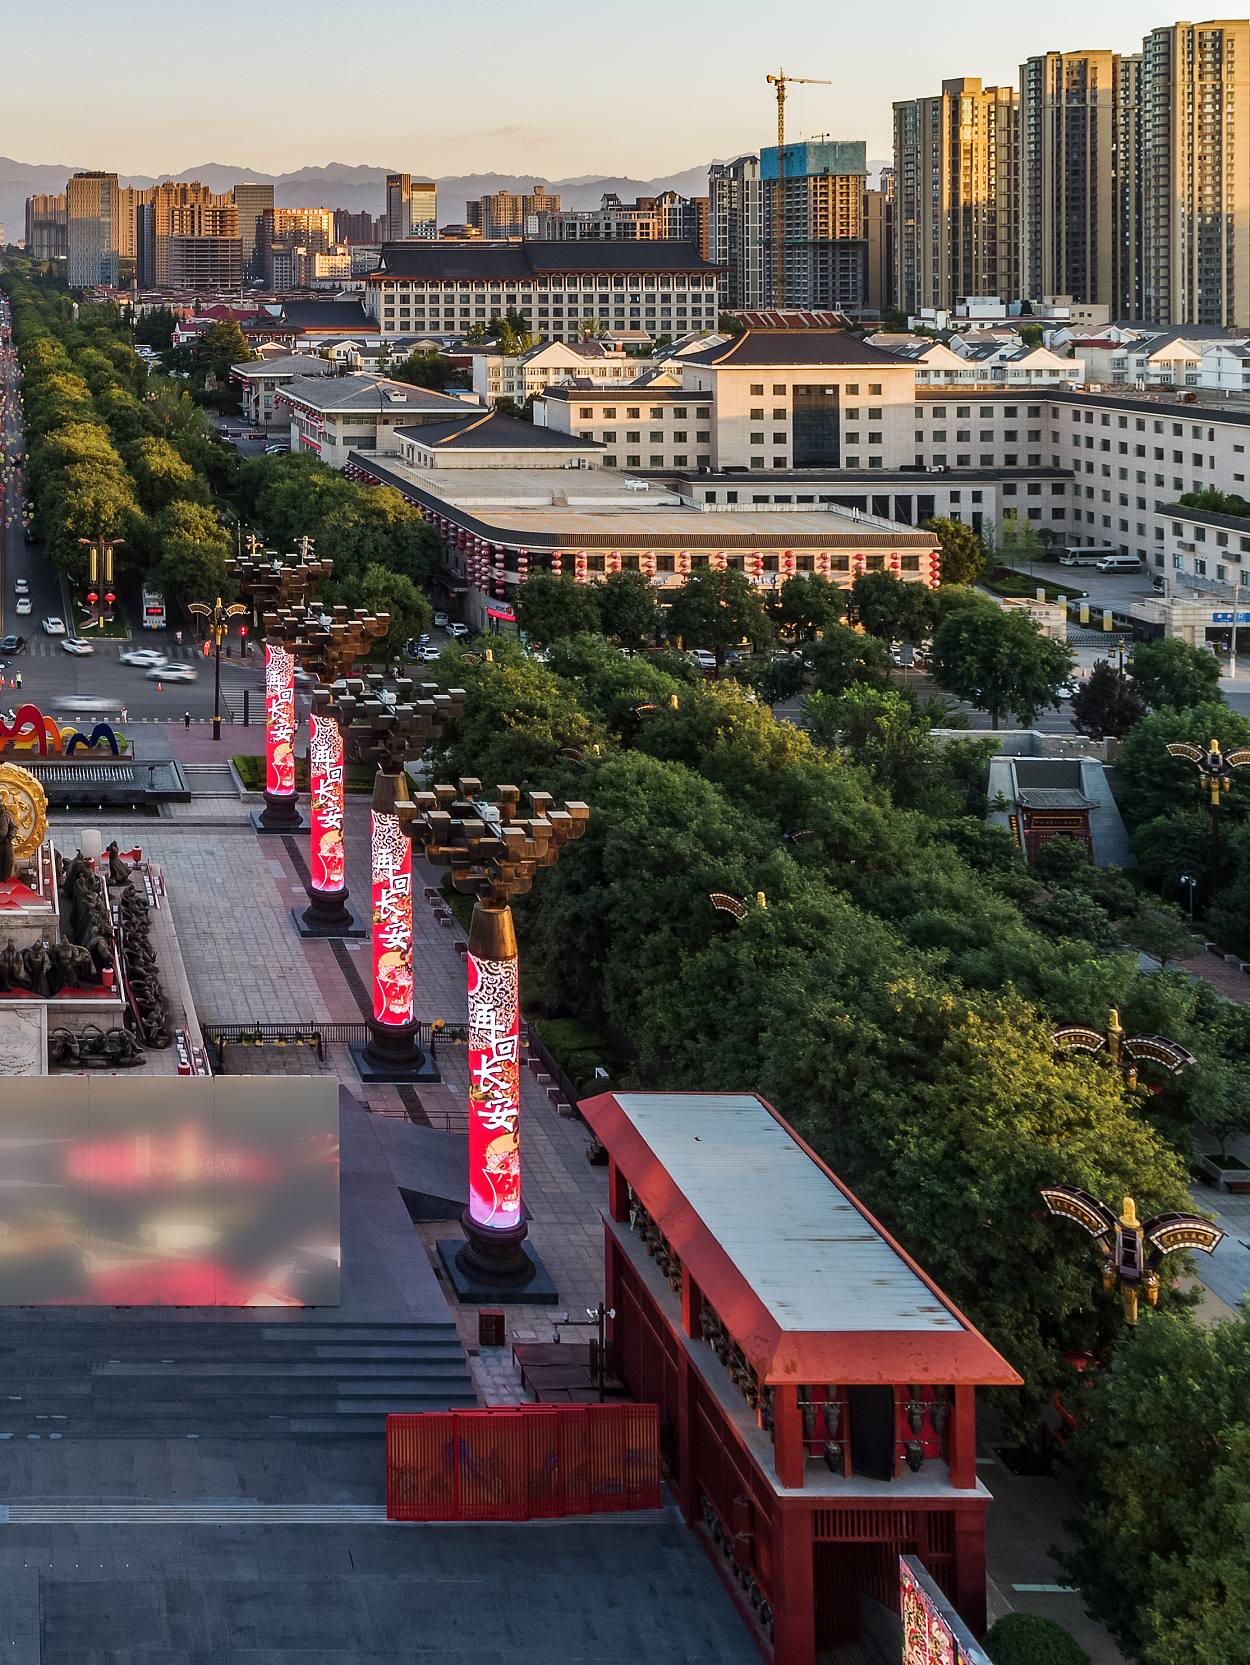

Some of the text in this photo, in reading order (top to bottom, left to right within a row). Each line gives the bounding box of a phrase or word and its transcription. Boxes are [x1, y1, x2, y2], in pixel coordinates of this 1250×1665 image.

[267, 670, 294, 742] 再回长安
[311, 745, 344, 829] 再回长安
[373, 849, 412, 950] 再回长安
[470, 1003, 518, 1132] 再回长安
